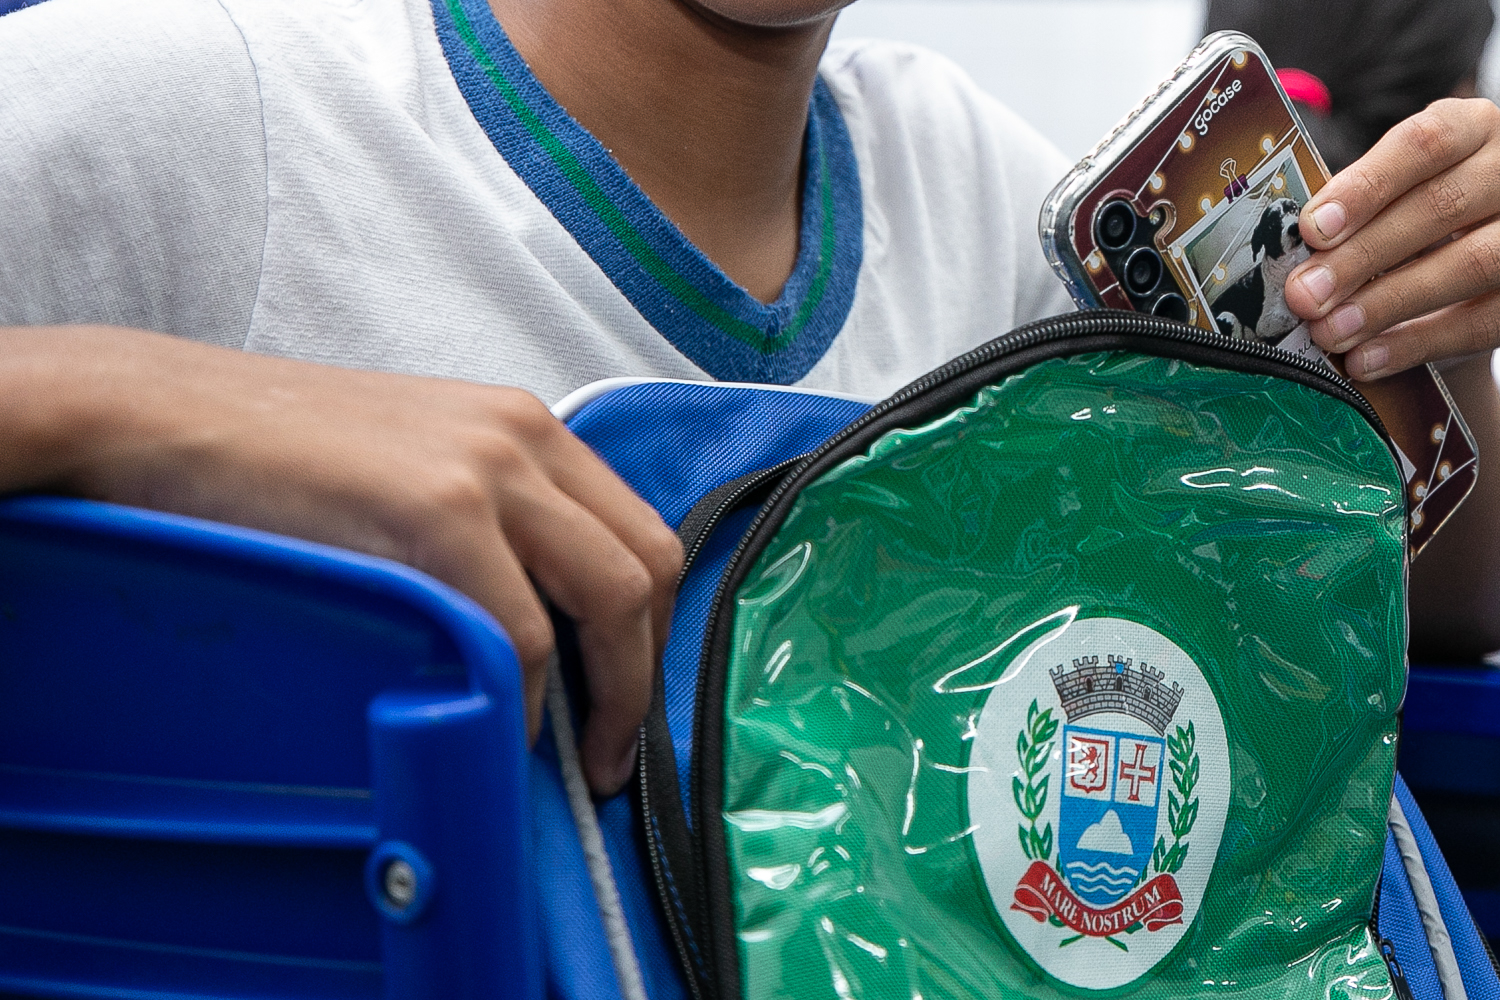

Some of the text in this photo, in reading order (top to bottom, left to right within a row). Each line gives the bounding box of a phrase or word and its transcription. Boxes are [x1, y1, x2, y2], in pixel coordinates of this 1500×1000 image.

[1194, 79, 1243, 136] gocase
[1040, 871, 1162, 932] MARE NOSTRUM
